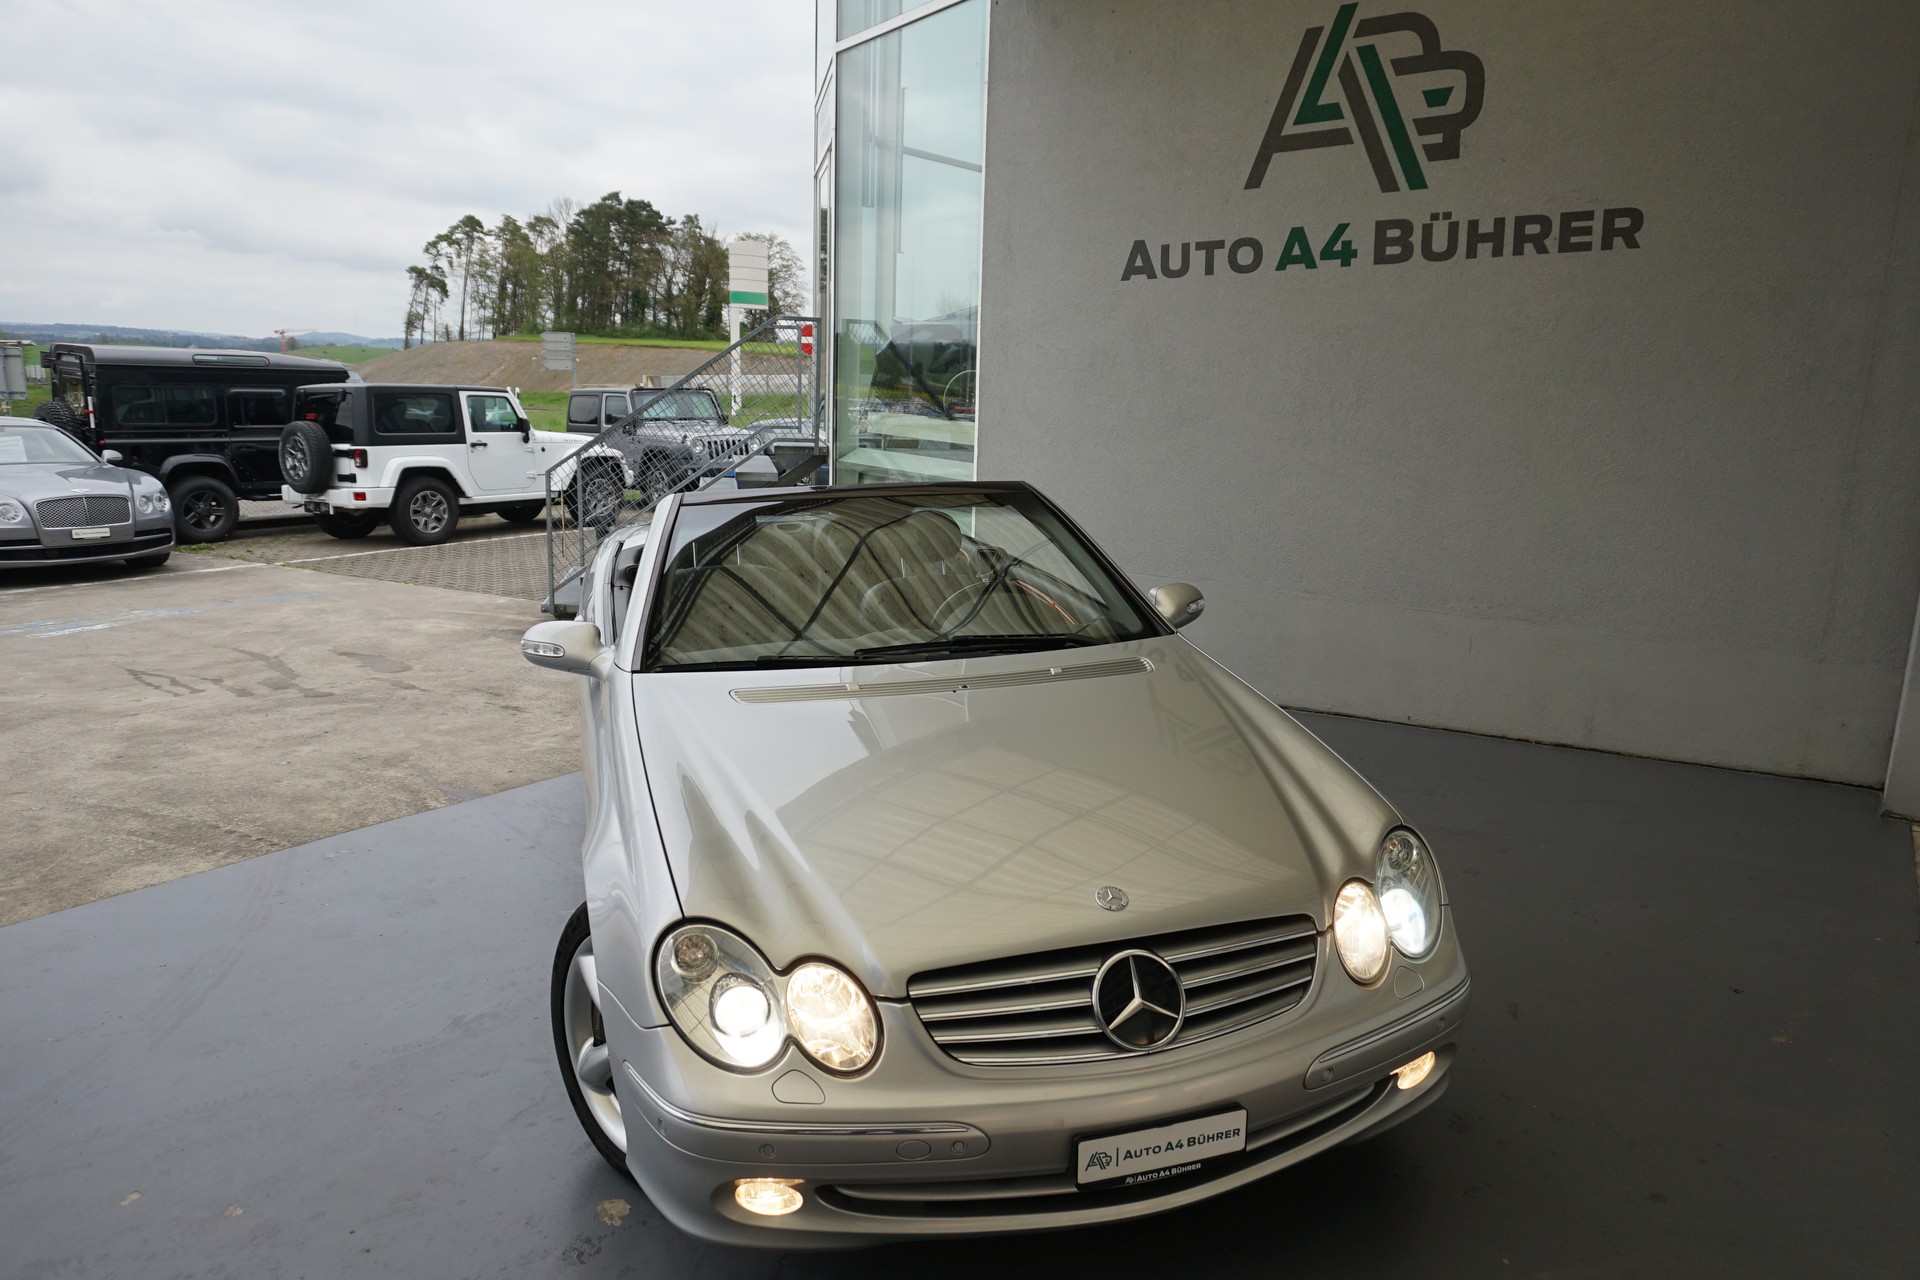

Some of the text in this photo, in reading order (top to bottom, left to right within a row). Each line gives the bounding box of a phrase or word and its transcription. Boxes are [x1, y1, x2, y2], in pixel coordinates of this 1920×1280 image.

[1120, 206, 1645, 282] AUTO A4 BÜHRER
[1123, 1127, 1241, 1161] AUTO A4 BÜHRER
[1136, 1172, 1159, 1182] AUTO
[1159, 1169, 1171, 1177] A4
[1171, 1163, 1202, 1175] BÜHRER
